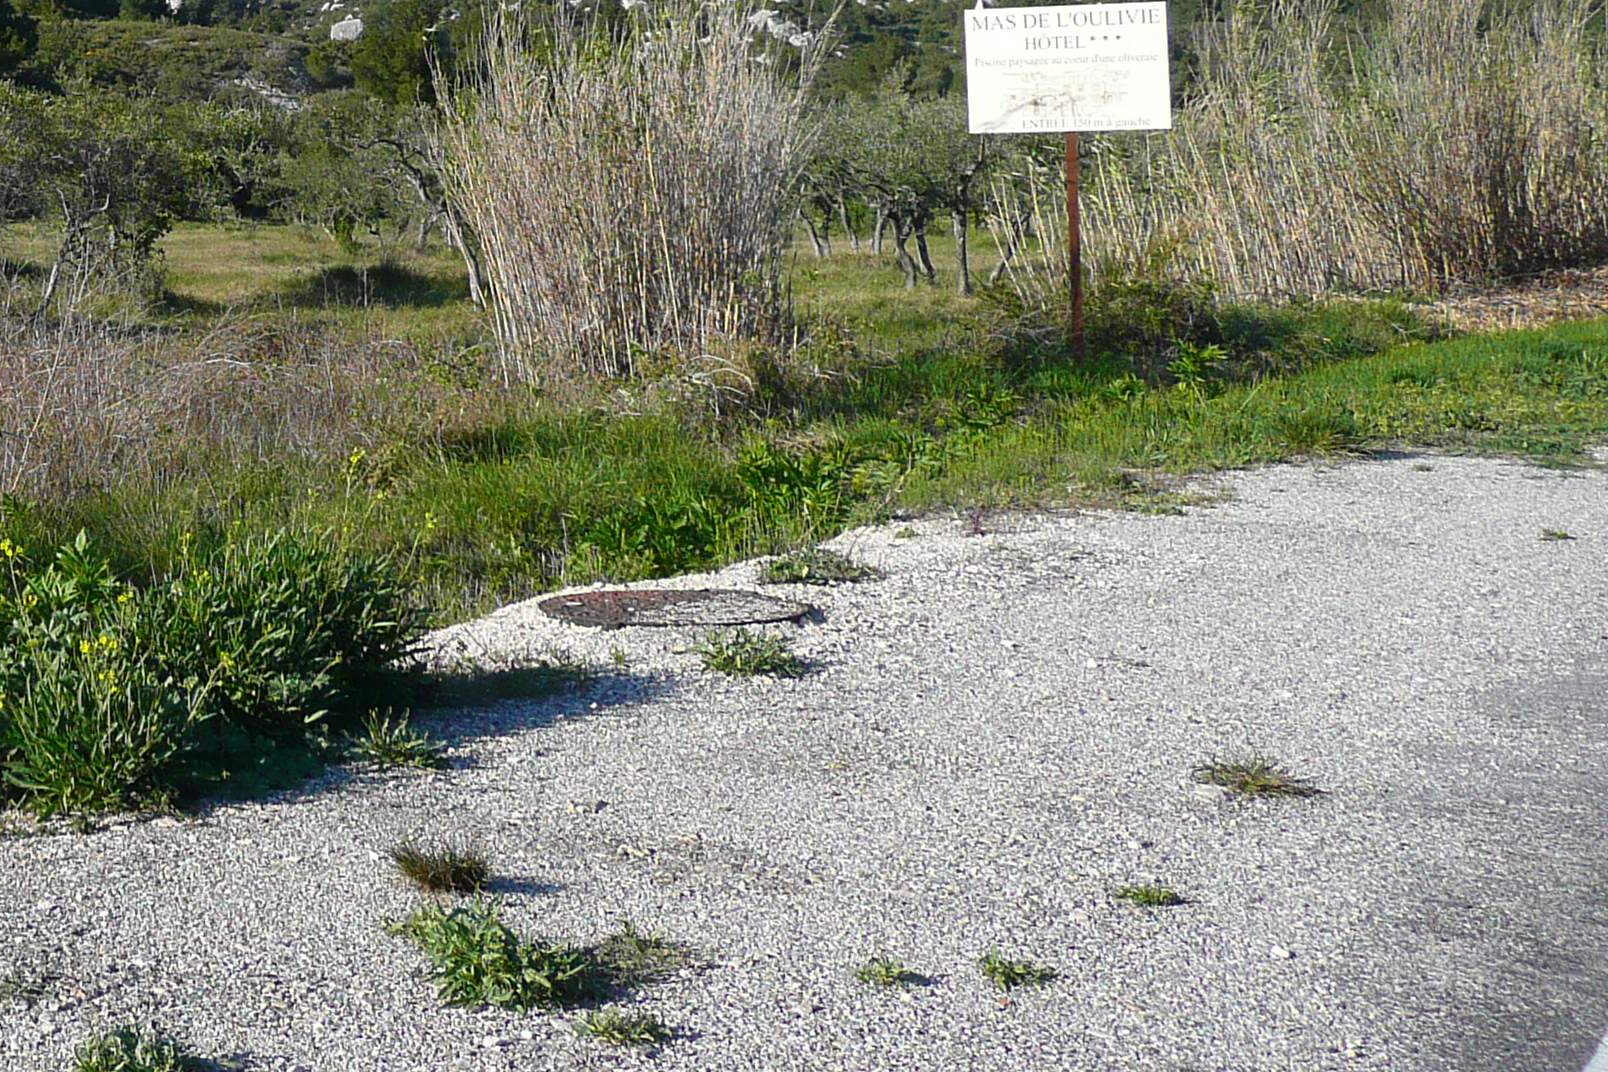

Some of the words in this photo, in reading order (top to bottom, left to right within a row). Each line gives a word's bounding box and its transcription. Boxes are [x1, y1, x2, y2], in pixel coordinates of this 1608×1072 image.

[972, 14, 1017, 31] MAS
[1023, 13, 1051, 29] DE
[1025, 33, 1086, 50] HÔTEL
[974, 57, 1007, 67] Piscine
[1008, 55, 1049, 68] paysagée
[1051, 57, 1062, 65] au
[1091, 53, 1116, 63] d'une
[1118, 52, 1159, 62] oliveraie
[1073, 118, 1091, 128] 150
[1094, 119, 1104, 127] m
[1115, 116, 1151, 128] gauche
